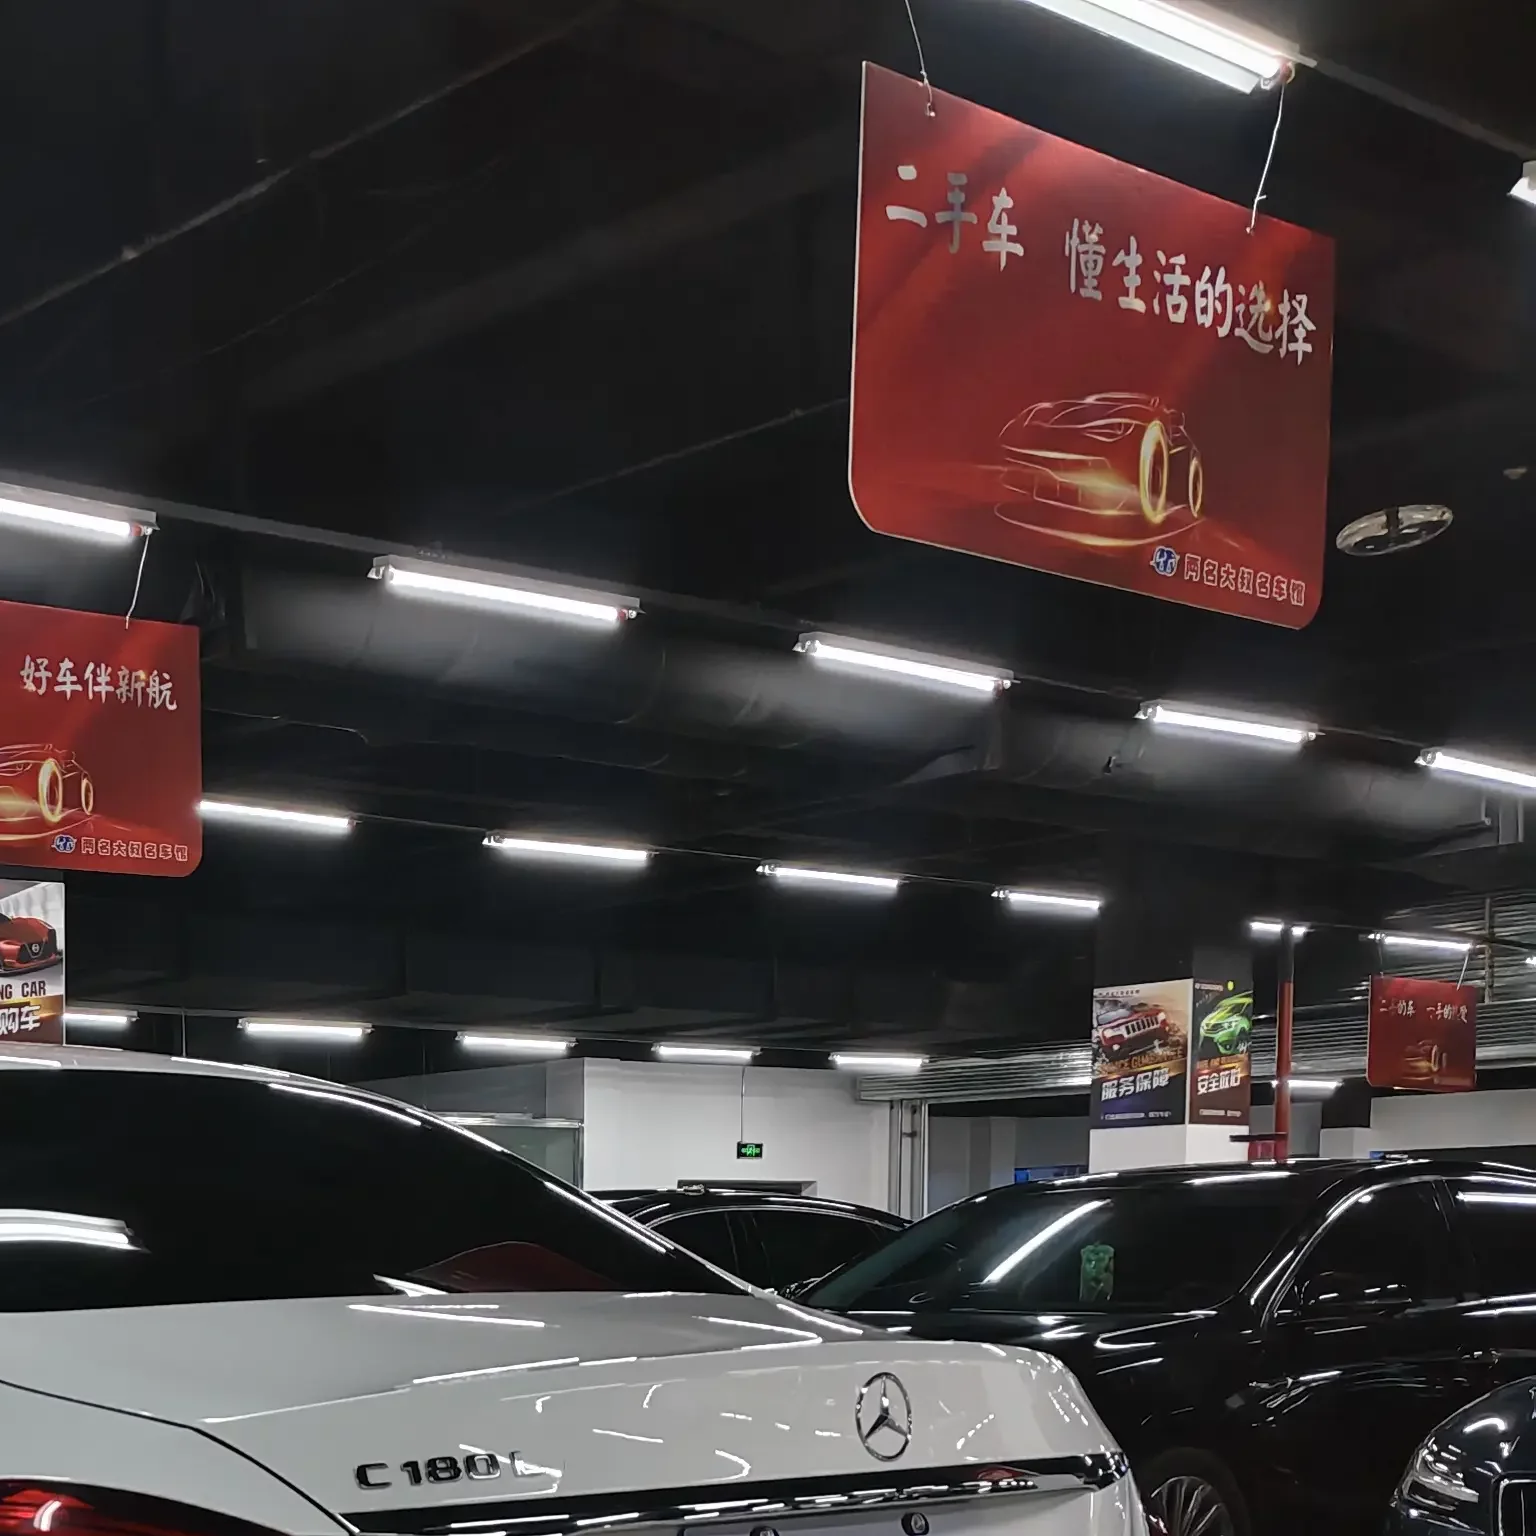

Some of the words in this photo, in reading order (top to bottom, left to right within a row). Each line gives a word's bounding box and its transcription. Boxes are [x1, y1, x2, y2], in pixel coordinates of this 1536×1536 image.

[885, 164, 1024, 272] 二手车
[1064, 216, 1316, 366] 懂生活的选择
[19, 654, 178, 712] 好车伴新航
[21, 980, 47, 998] CAR
[1100, 1067, 1170, 1101] 服务保障
[354, 1463, 391, 1489] C
